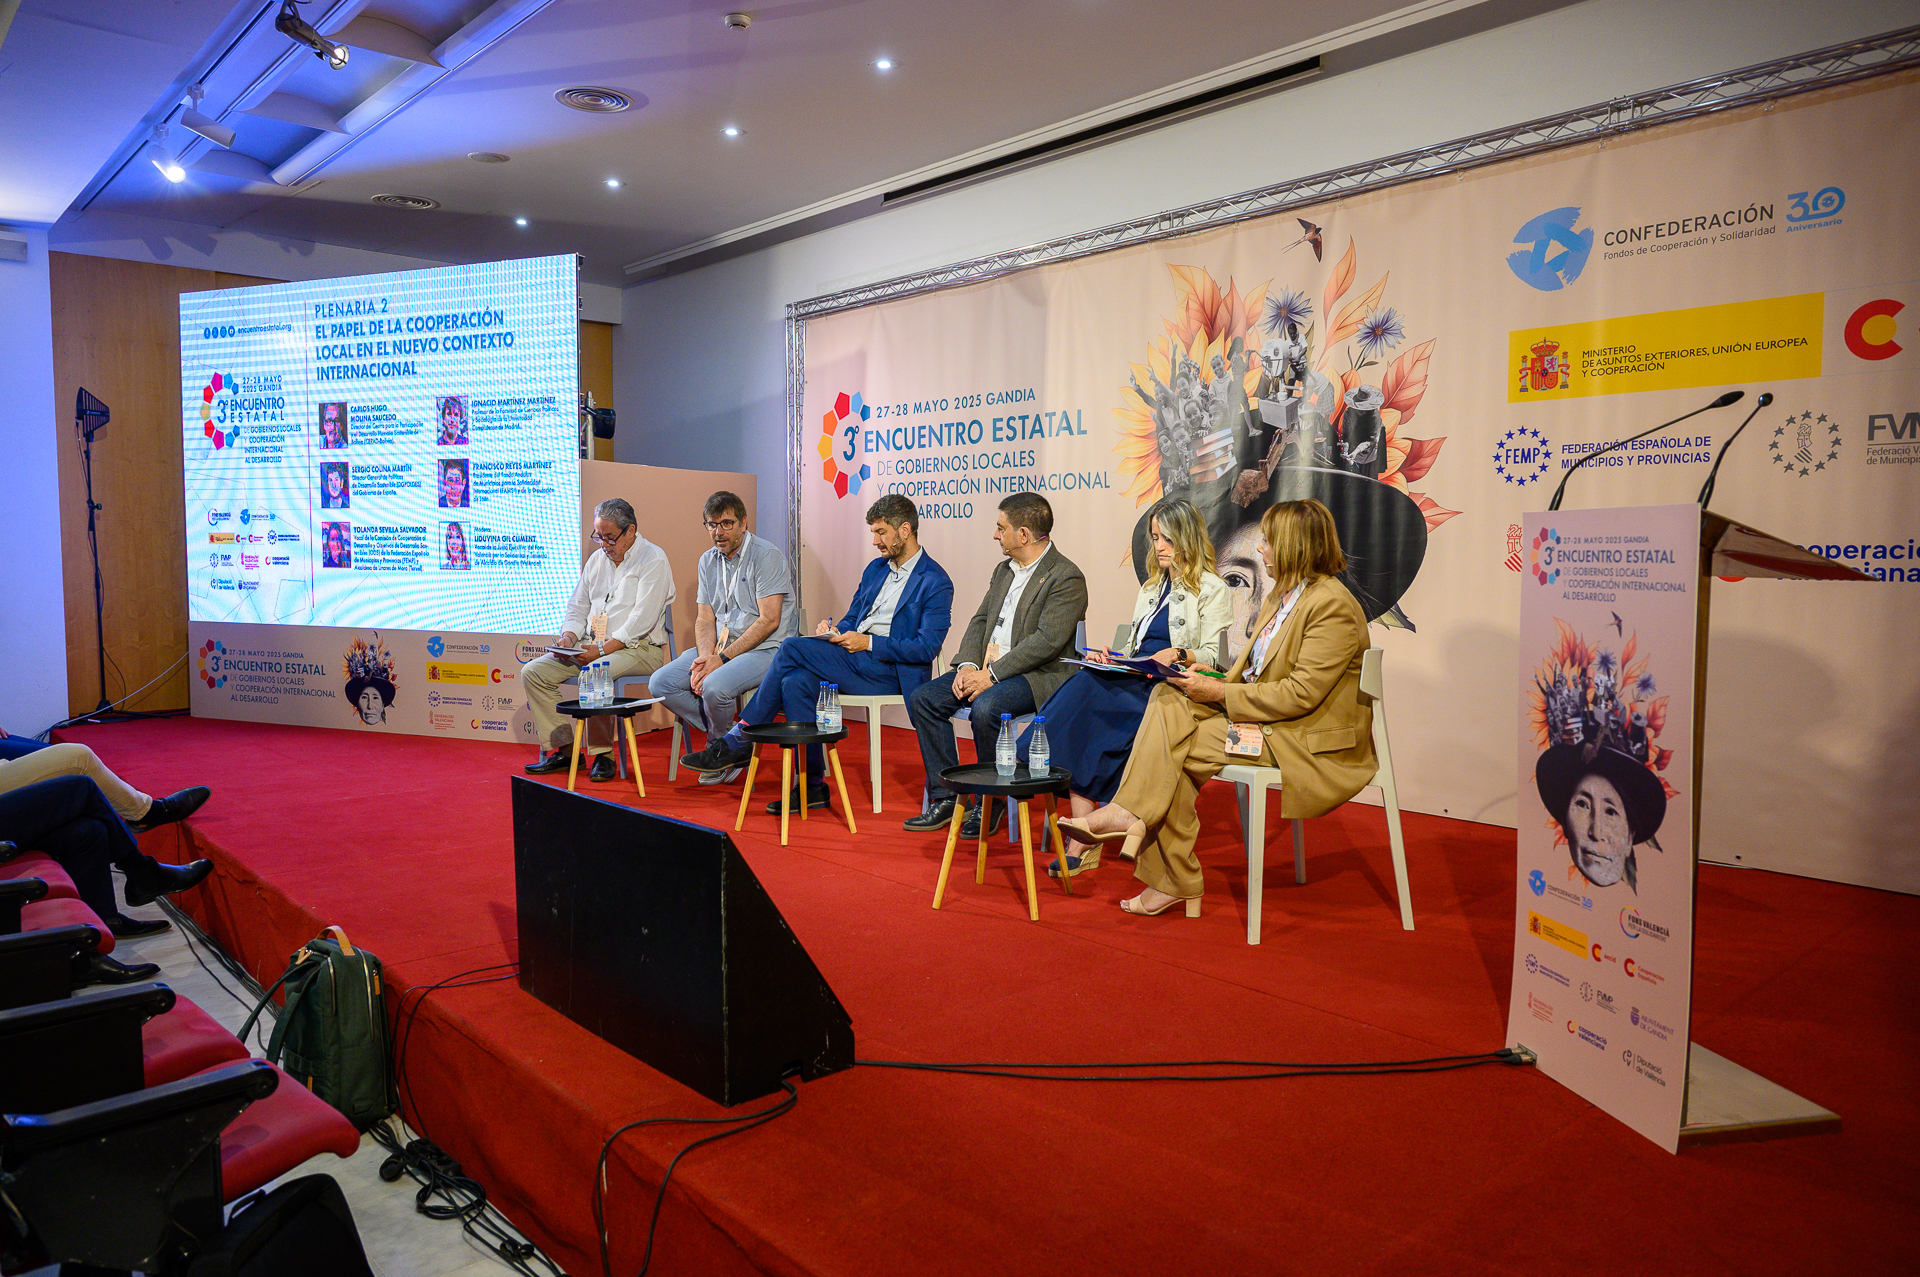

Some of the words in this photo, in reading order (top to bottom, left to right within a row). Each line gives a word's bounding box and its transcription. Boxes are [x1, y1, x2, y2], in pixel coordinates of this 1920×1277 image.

[1603, 202, 1775, 246] CONFEDERACIÓN
[1785, 217, 1843, 233] Aniversario
[1603, 247, 1635, 261] Fondos
[1636, 245, 1648, 255] de
[1650, 235, 1708, 254] Cooperación
[1711, 235, 1717, 246] y
[1719, 225, 1776, 243] Solidaridad
[315, 299, 376, 319] PLENARIA
[381, 297, 388, 313] 2
[316, 325, 327, 340] EL
[331, 321, 365, 339] PAPEL
[369, 319, 384, 336] DE
[387, 318, 403, 335] LA
[406, 306, 504, 333] COOPERACIÓN
[316, 343, 354, 361] LOCAL
[357, 342, 373, 358] EN
[377, 341, 390, 357] EL
[393, 336, 439, 355] NUEVO
[443, 331, 515, 352] CONTEXTO
[1582, 344, 1636, 359] MINISTERIO
[1582, 359, 1595, 368] DE
[1595, 354, 1642, 367] ASUNTOS
[1645, 347, 1710, 362] EXTERIORES,
[1712, 341, 1752, 355] UNIÓN
[1755, 336, 1809, 351] EUROPEA
[316, 360, 417, 381] INTERNACIONAL
[1581, 369, 1589, 378] Y
[1590, 360, 1665, 377] COOPERACIÓN
[264, 375, 283, 383] MAYO
[258, 384, 283, 392] GANDIA
[230, 396, 285, 411] ENCUENTRO
[876, 403, 909, 419] 27-28
[913, 398, 949, 414] MAYO
[954, 393, 982, 410] 2025
[986, 387, 1036, 405] GANDIA
[230, 410, 285, 423] ESTATAL
[864, 419, 984, 453] ENCUENTRO
[992, 409, 1088, 443] ESTATAL
[1504, 447, 1541, 464] FEMP
[1561, 438, 1628, 455] FEDERACIÓN
[1631, 435, 1692, 451] ESPAÑOLA
[1694, 435, 1712, 447] DE
[1866, 445, 1911, 457] Federació
[877, 460, 893, 476] DE
[895, 454, 969, 475] GOBIERNOS
[972, 449, 1035, 471] LOCALES
[1627, 455, 1635, 466] Y
[1637, 451, 1711, 466] PROVINCIAS
[1866, 456, 1878, 465] de
[877, 483, 885, 498] Y
[888, 474, 981, 497] COOPERACIÓN
[985, 471, 1111, 494] INTERNACIONAL
[918, 501, 974, 520] ARROLLO
[1563, 537, 1581, 545] 27-28
[1583, 536, 1604, 544] MAYO
[1605, 536, 1622, 544] 2025
[1623, 536, 1649, 544] GANDIA
[1557, 550, 1623, 564] ENCUENTRO
[1626, 549, 1676, 564] ESTATAL
[1797, 539, 1920, 561] operaci
[1572, 567, 1614, 577] GOBIERNOS
[1615, 568, 1649, 578] LOCALES
[1568, 578, 1620, 590] COOPERACIÓN
[1622, 582, 1687, 593] INTERNACIONAL
[1562, 591, 1571, 600] AL
[1571, 591, 1616, 602] DESARROLLO
[228, 648, 246, 656] 27-28
[247, 650, 265, 658] MAYO
[267, 650, 281, 658] 2025
[282, 651, 304, 659] GANDIA
[223, 659, 283, 674] ENCUENTRO
[285, 662, 326, 676] ESTATAL
[238, 674, 276, 684] GOBIERNOS
[277, 677, 305, 686] LOCALES
[235, 683, 282, 695] COOPERACIÓN
[283, 687, 336, 698] INTERNACIONAL
[230, 694, 239, 702] AL
[239, 695, 279, 704] DESARROLLO
[1628, 914, 1643, 927] FONS
